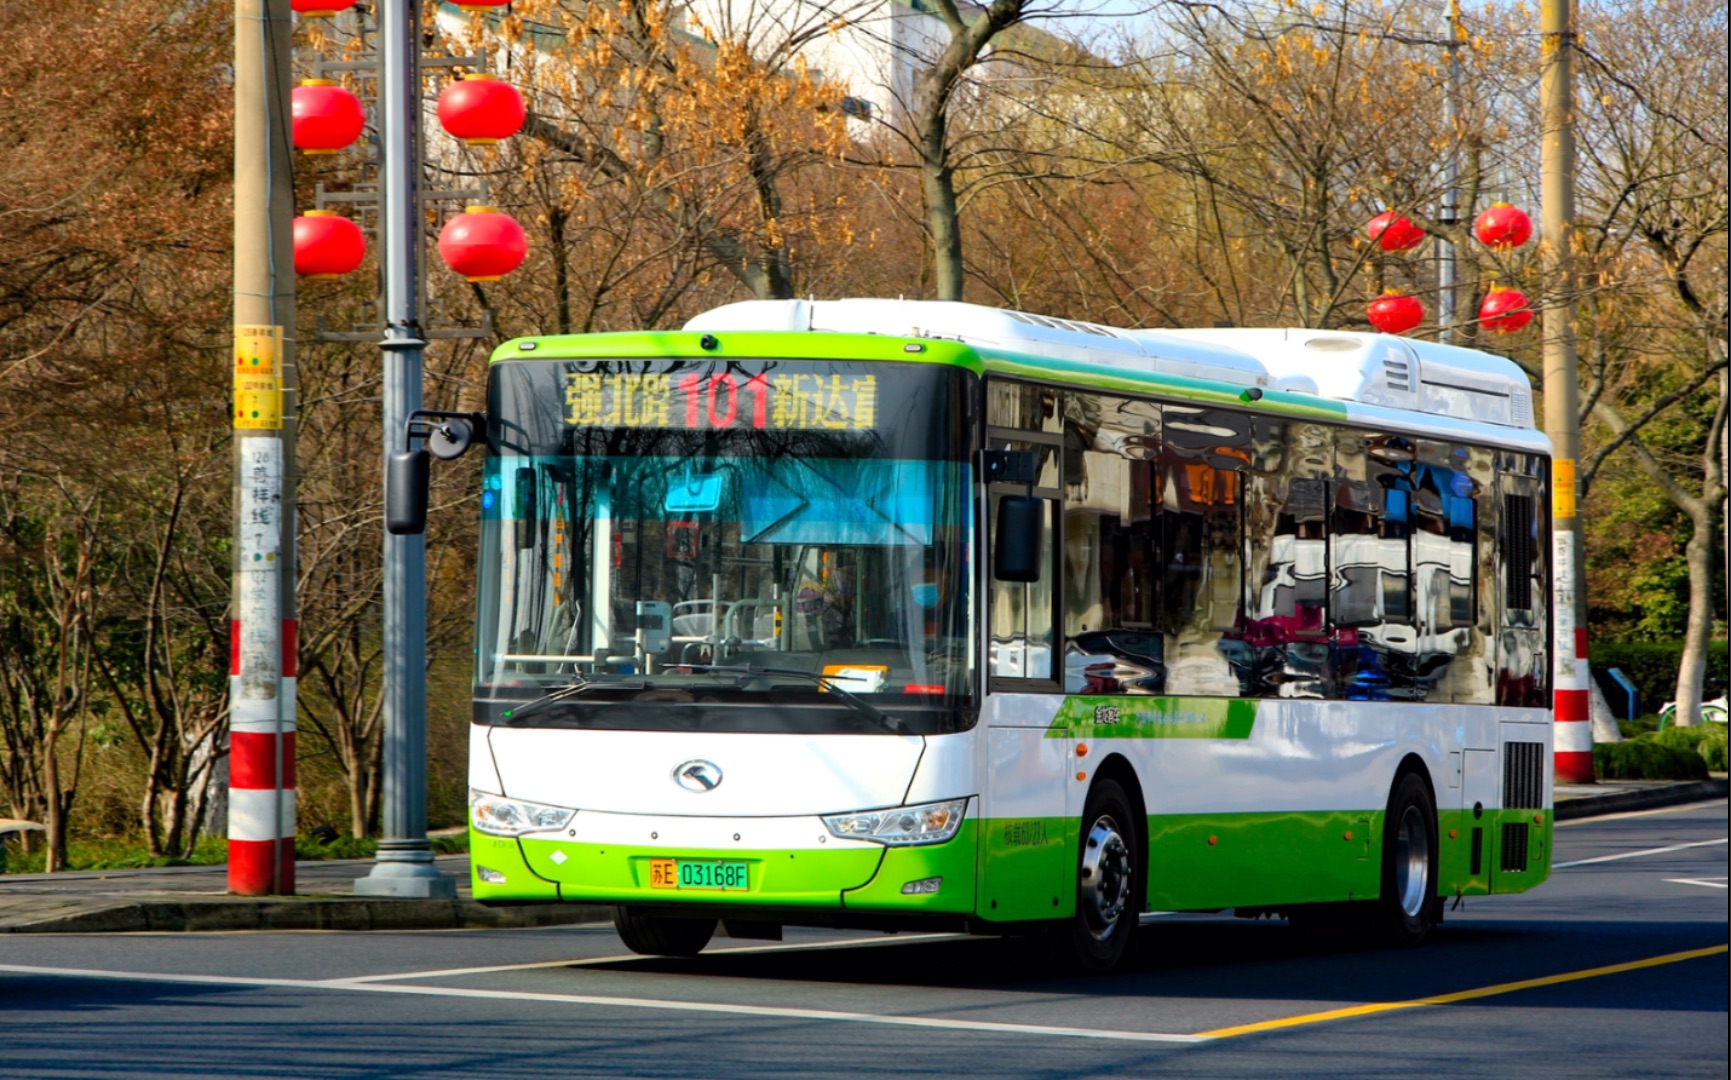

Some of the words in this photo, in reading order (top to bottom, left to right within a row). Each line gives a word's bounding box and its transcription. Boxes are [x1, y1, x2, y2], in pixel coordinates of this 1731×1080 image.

[565, 373, 670, 428] 强北路
[678, 372, 768, 429] 101
[653, 863, 674, 884] 苏E
[682, 864, 745, 886] 03168F
